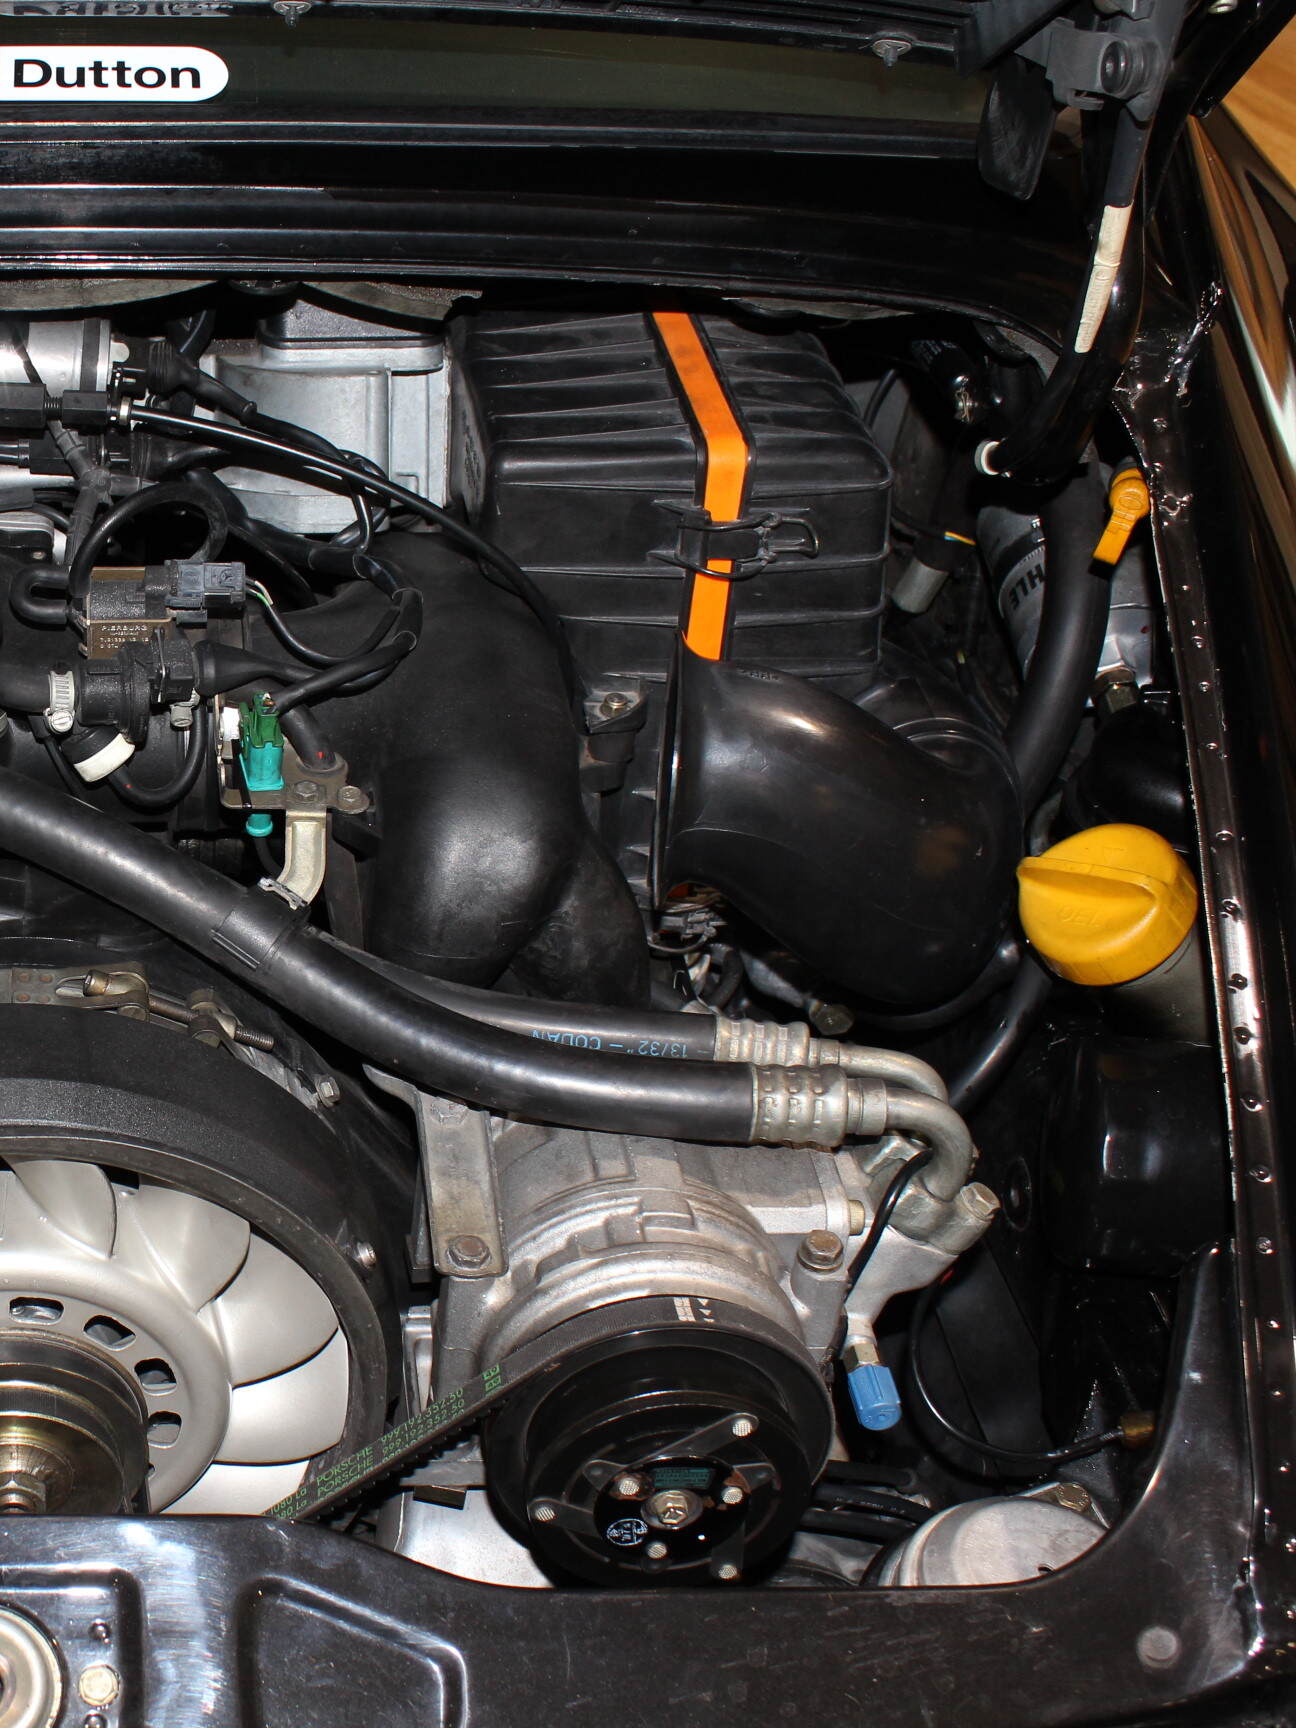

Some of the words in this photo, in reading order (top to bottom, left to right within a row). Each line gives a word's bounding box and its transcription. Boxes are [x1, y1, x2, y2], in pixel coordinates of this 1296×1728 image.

[13, 58, 201, 89] Dutton
[1008, 563, 1046, 610] HLE
[315, 1446, 374, 1486] PORSCHE
[380, 1387, 465, 1443] 999.192.352.50
[316, 1456, 375, 1497] PORSCHE
[382, 1398, 466, 1455] 999.192.352.50
